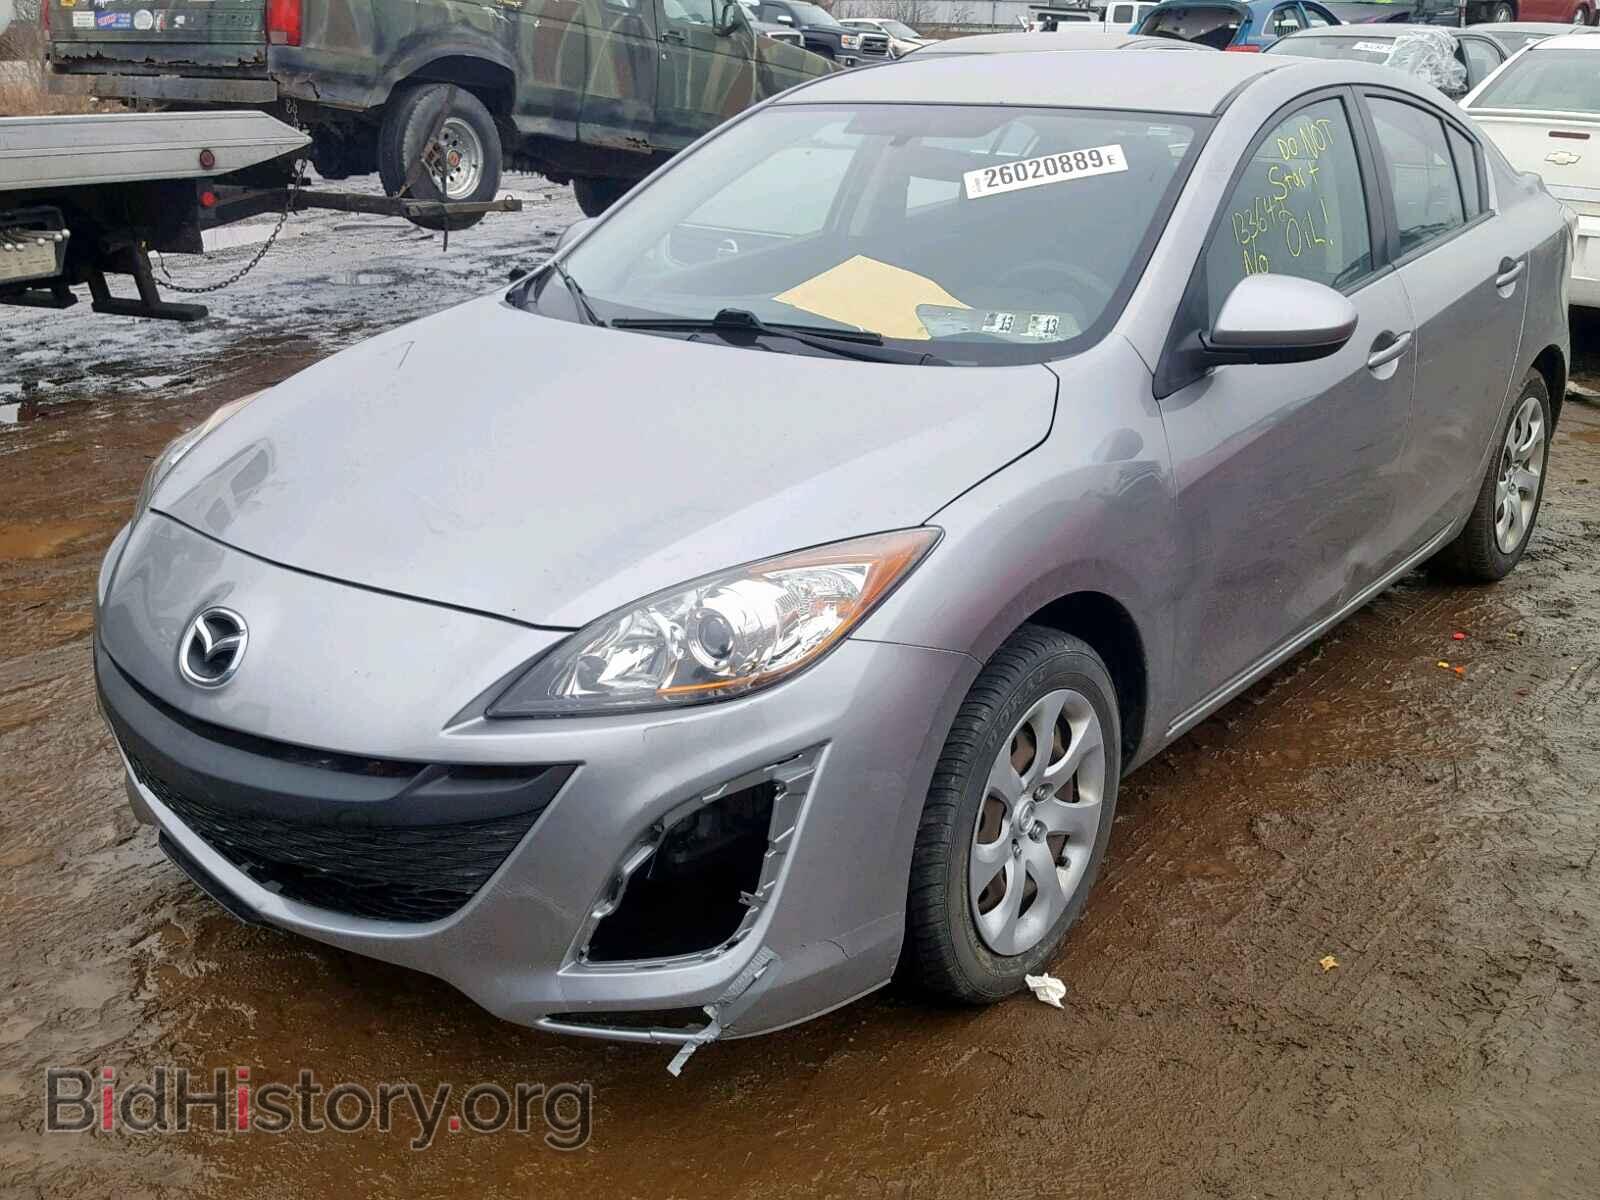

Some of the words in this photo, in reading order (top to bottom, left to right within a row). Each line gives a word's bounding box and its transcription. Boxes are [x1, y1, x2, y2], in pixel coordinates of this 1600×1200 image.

[1277, 137, 1299, 161] DO
[1300, 119, 1334, 159] NOT
[984, 149, 1104, 188] 26020889
[1107, 154, 1117, 166] E
[999, 315, 1014, 331] 13
[1043, 318, 1058, 334] 13
